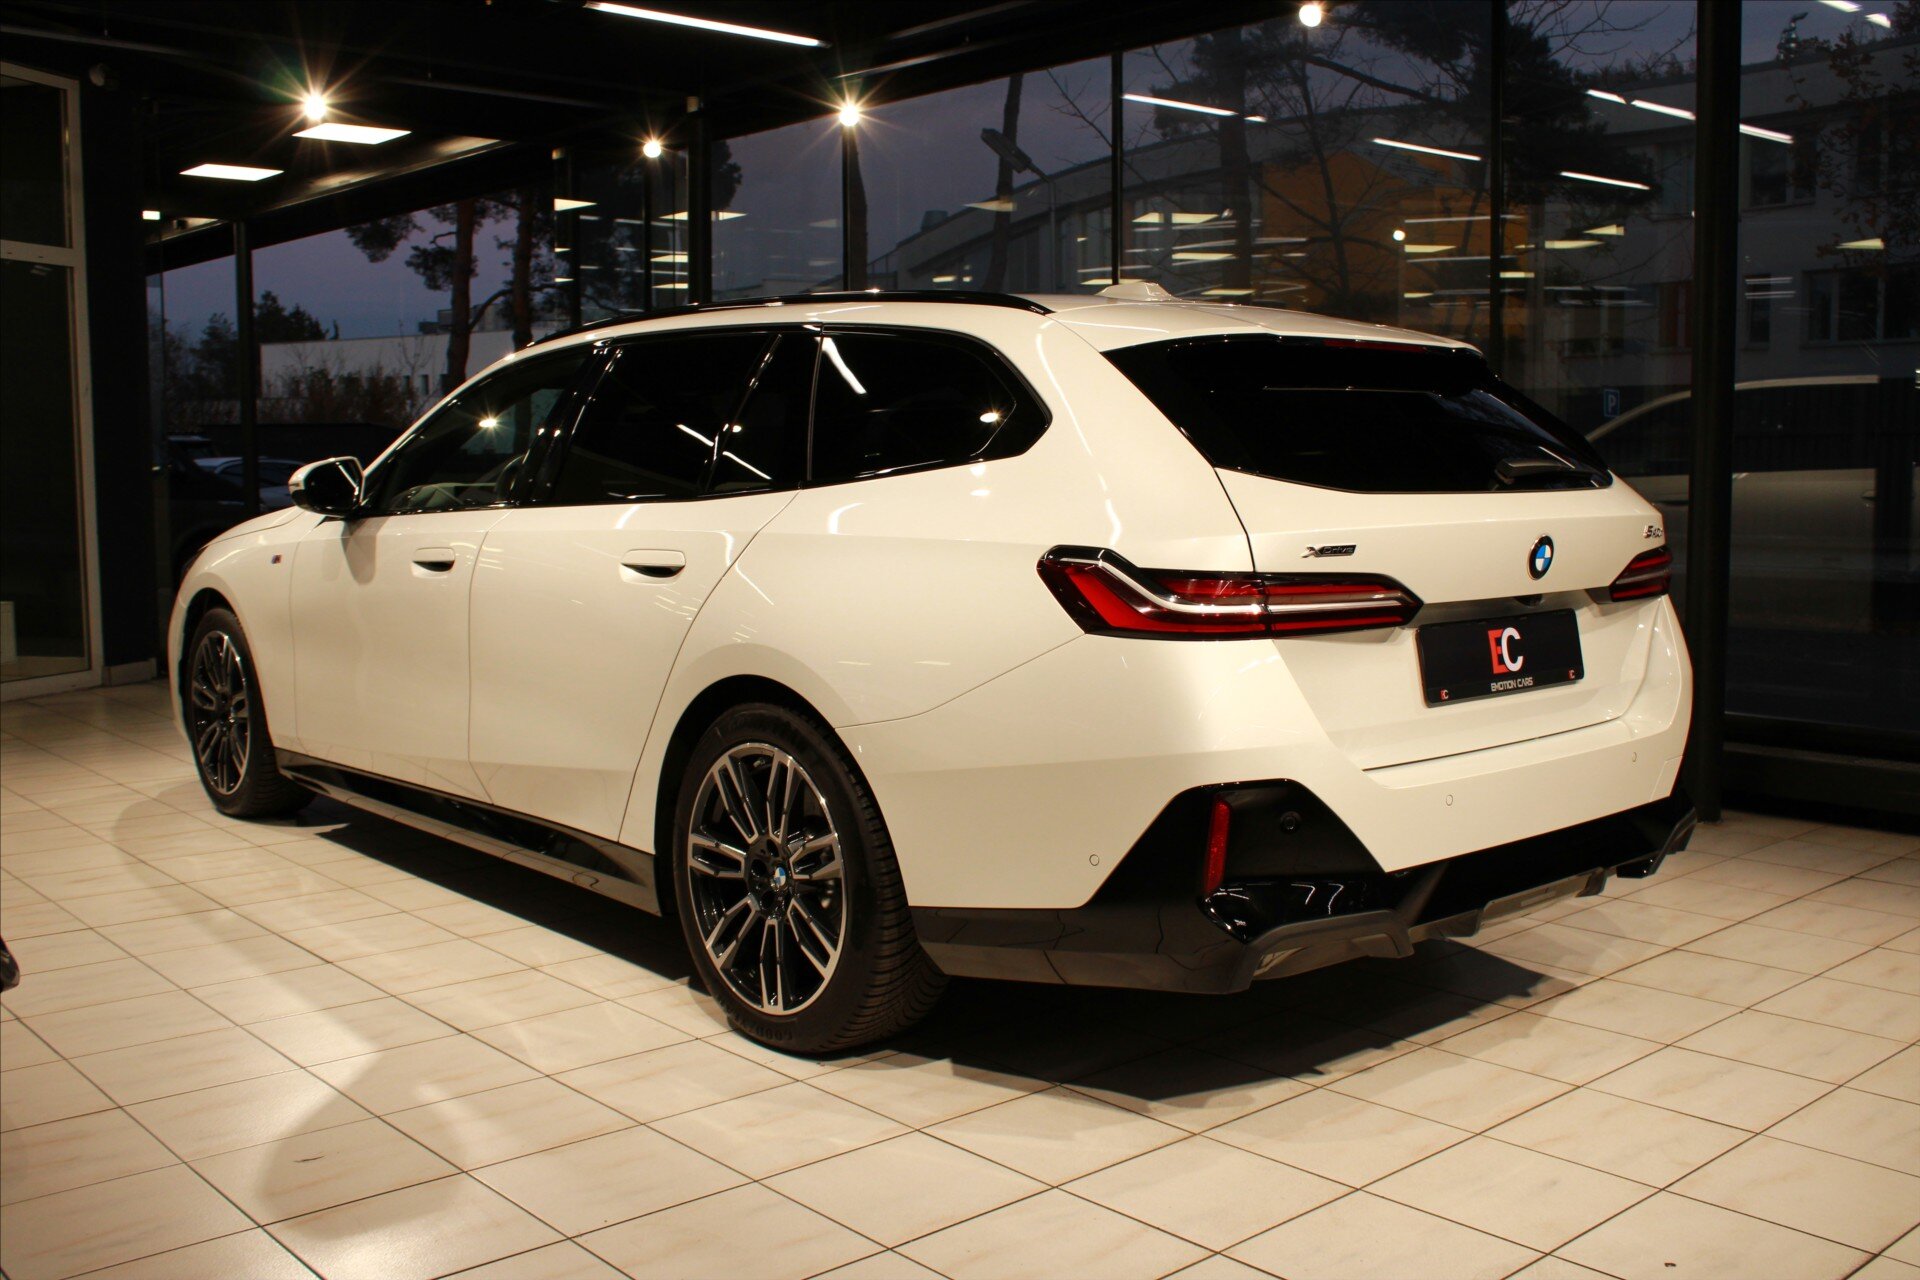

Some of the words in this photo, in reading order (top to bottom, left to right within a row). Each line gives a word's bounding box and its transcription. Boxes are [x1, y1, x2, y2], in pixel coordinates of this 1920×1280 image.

[1487, 627, 1525, 674] EC
[1490, 680, 1517, 692] EMOTION
[1517, 676, 1534, 688] CARS
